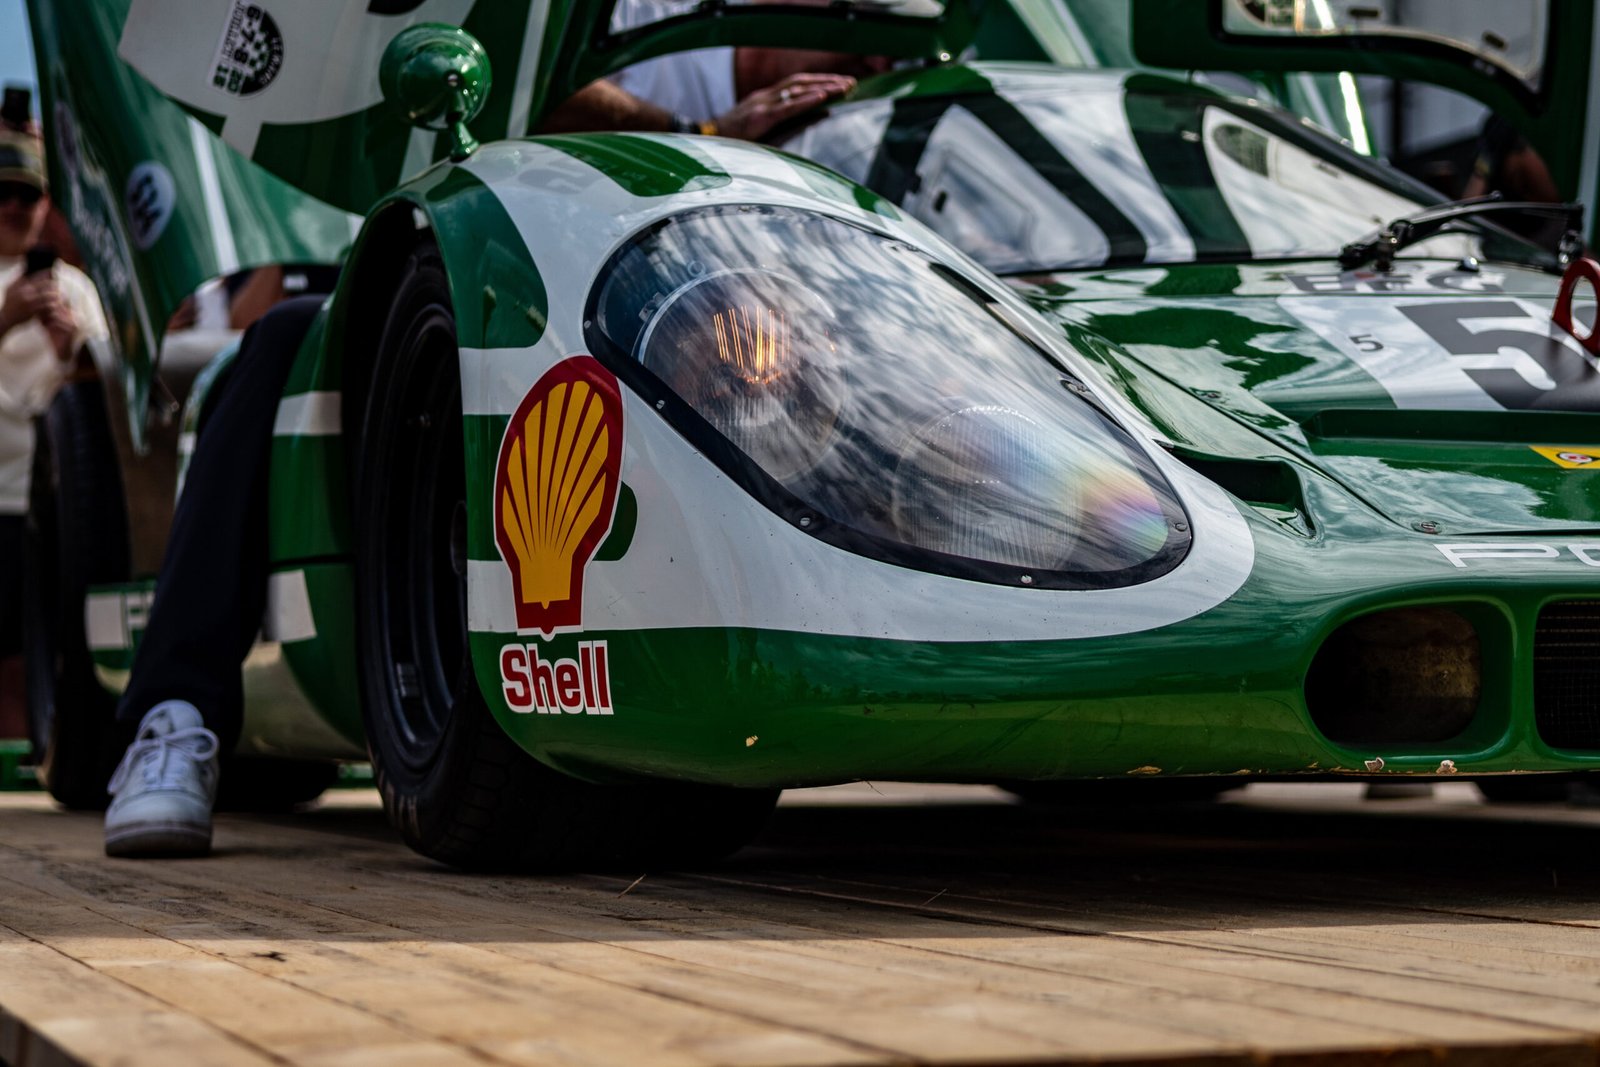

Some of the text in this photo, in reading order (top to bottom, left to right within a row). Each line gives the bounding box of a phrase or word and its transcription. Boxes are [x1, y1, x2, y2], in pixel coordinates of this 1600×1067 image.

[1349, 333, 1384, 353] 5
[1395, 300, 1600, 411] 5
[499, 640, 614, 715] Shell
